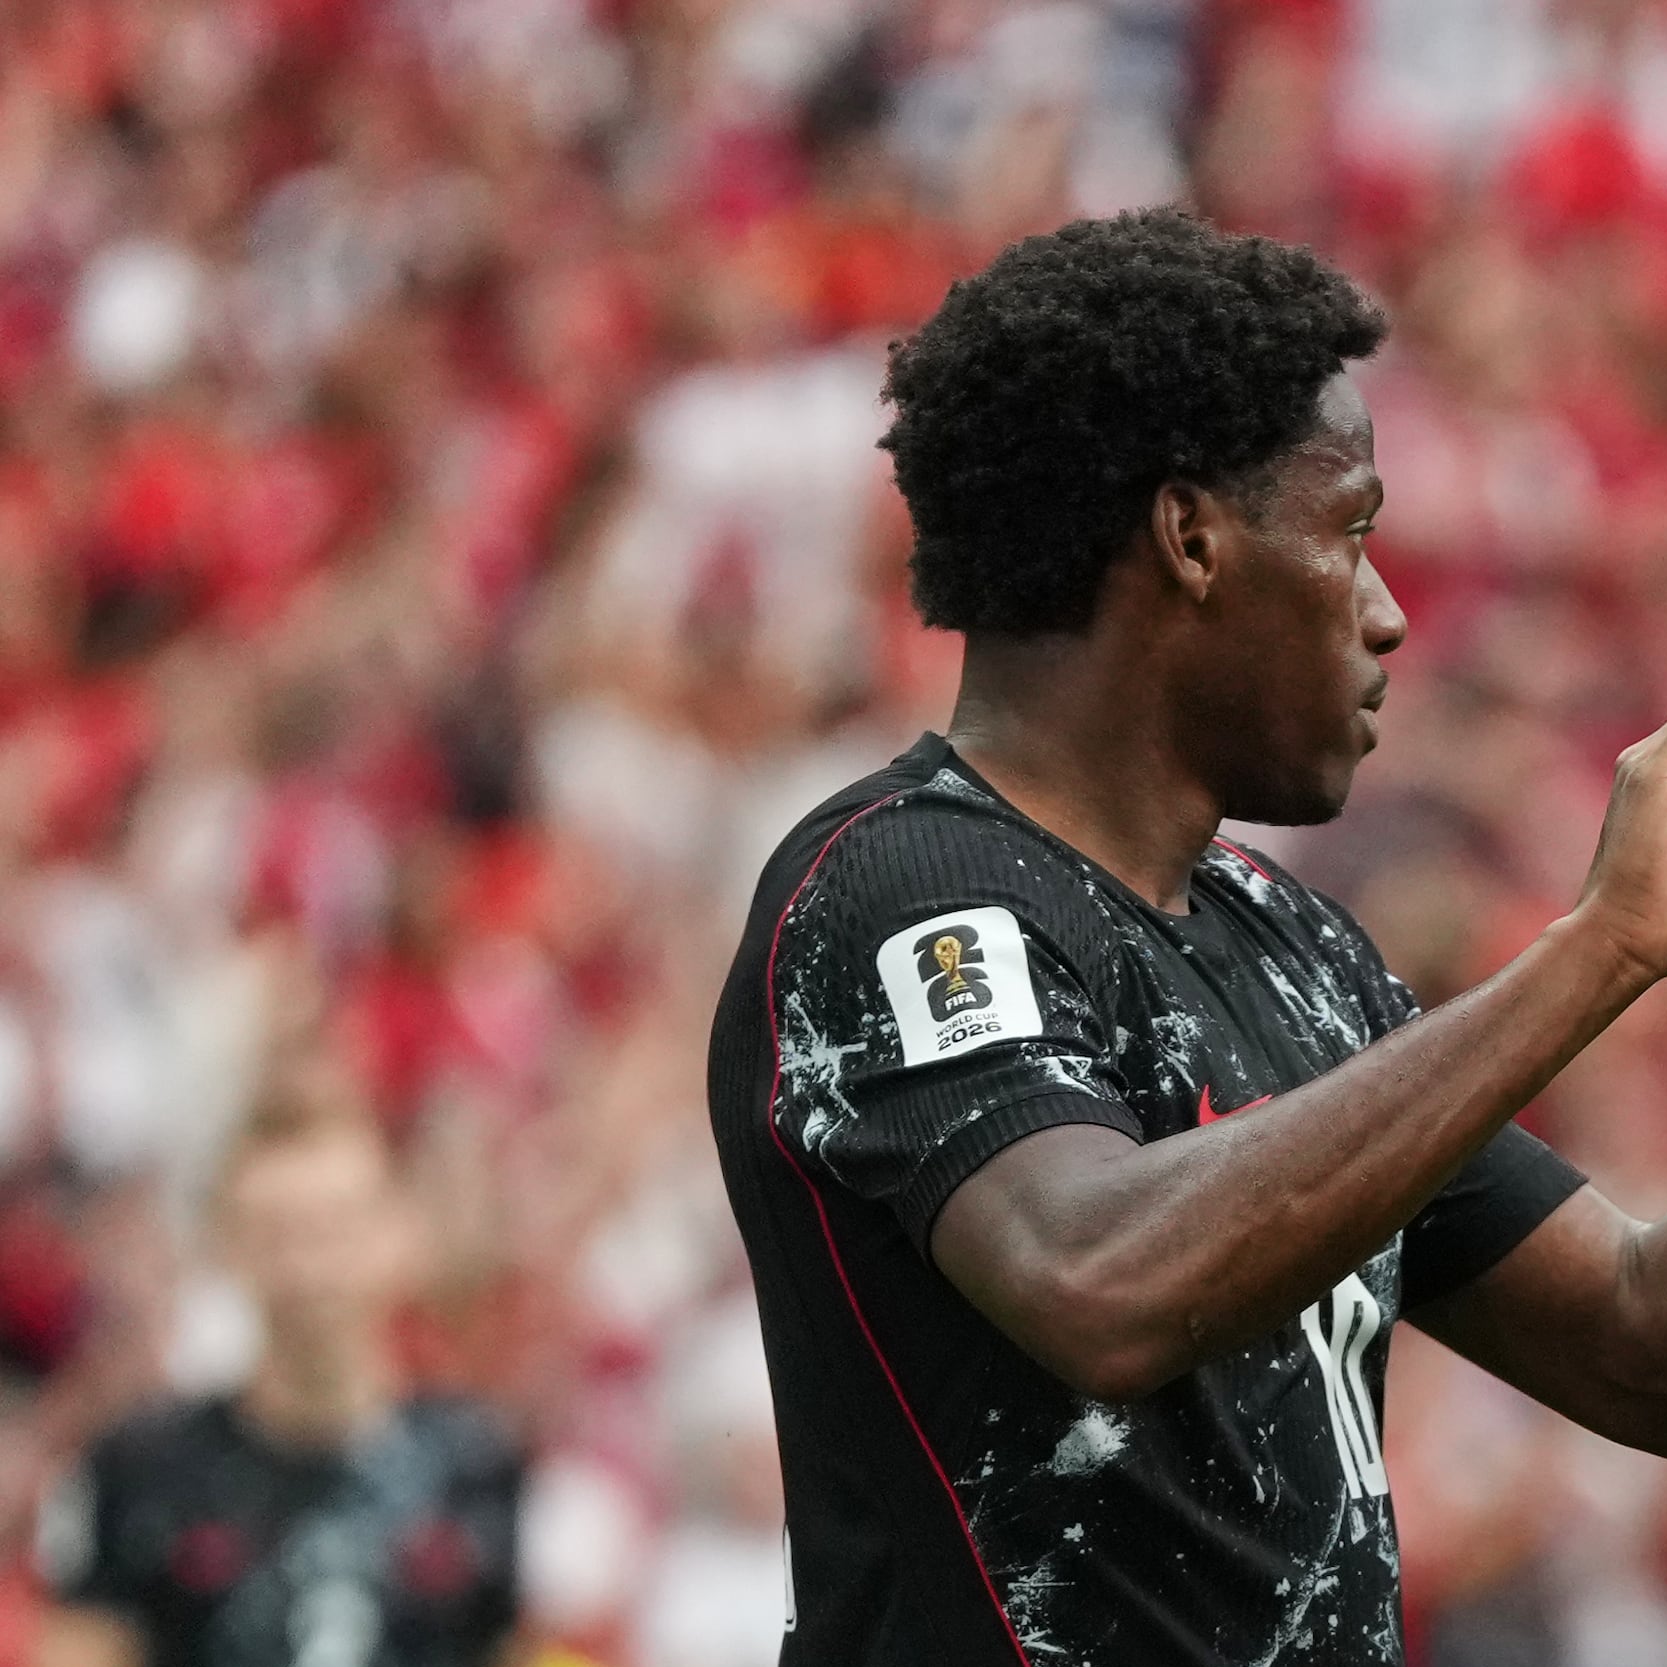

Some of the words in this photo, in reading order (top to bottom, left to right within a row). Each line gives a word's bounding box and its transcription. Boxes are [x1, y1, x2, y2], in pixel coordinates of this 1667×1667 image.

[944, 992, 977, 1011] FIFA
[935, 1014, 973, 1038] WORLD
[975, 1012, 999, 1021] CUP
[937, 1021, 1002, 1052] 2026
